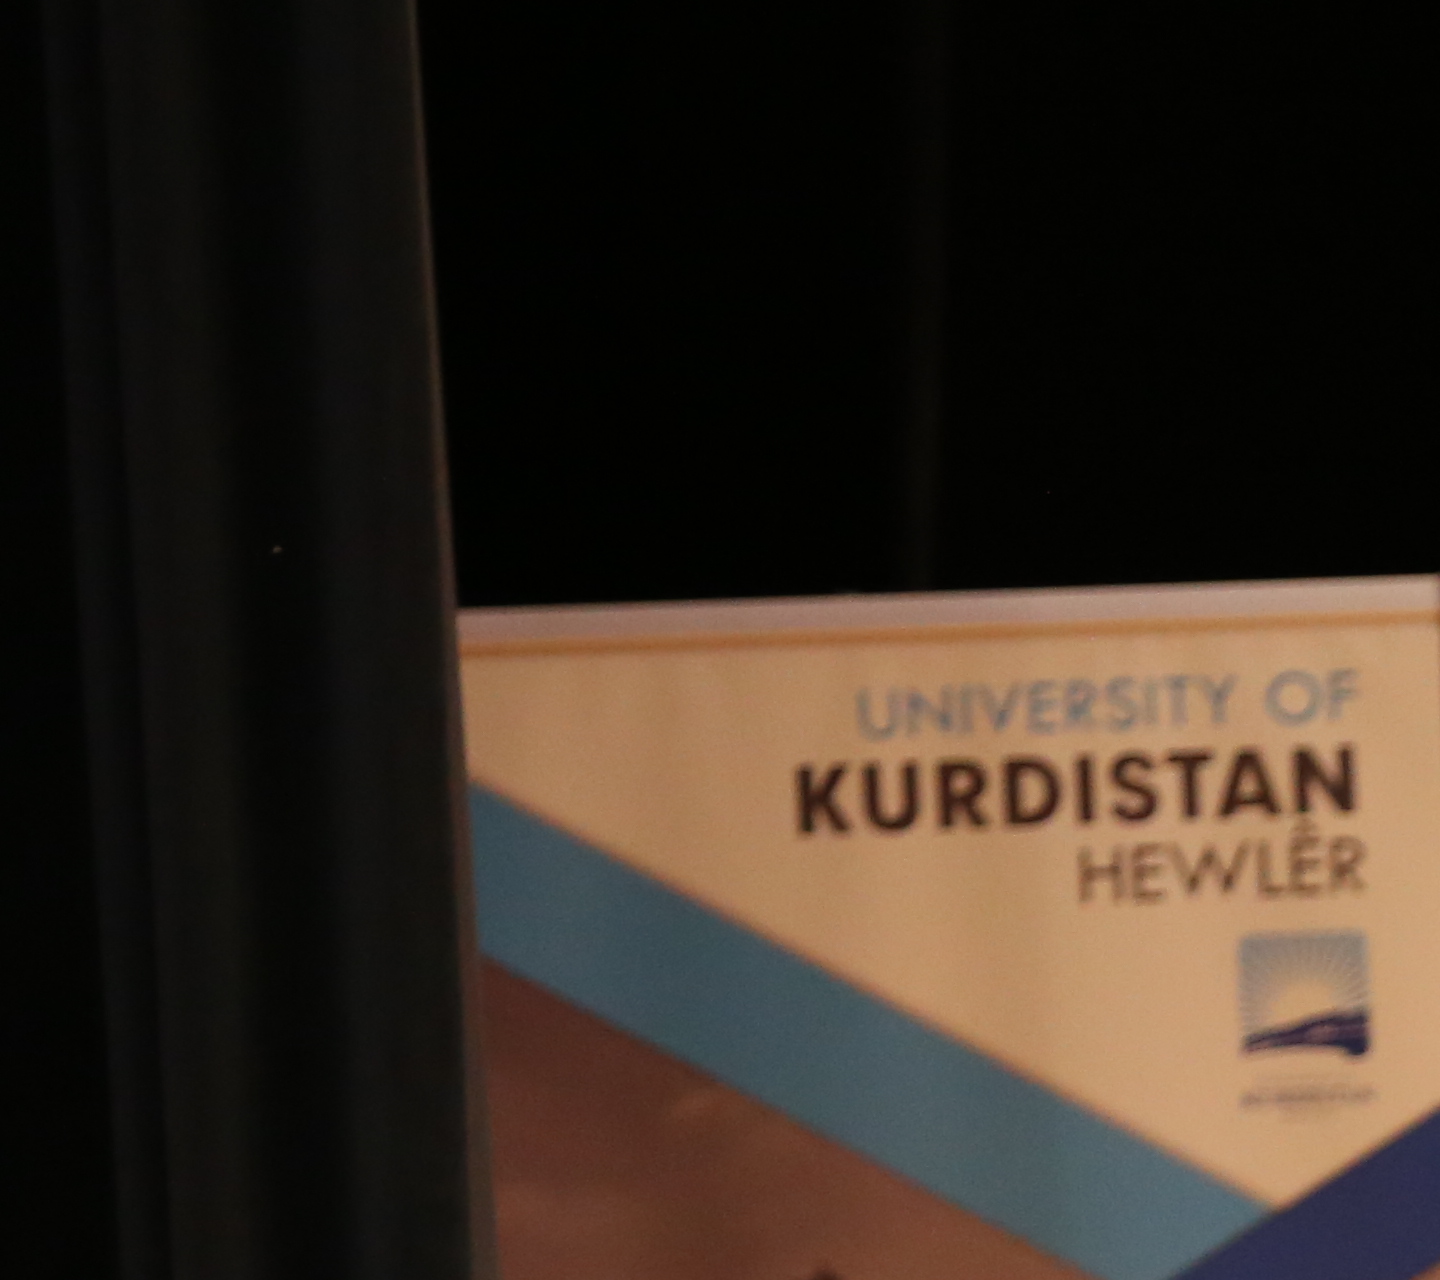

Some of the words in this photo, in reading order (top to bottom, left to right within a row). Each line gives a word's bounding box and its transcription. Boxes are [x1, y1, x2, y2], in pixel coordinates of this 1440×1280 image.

[858, 677, 1234, 739] UNIVERSITY
[1265, 670, 1361, 726] OF
[797, 744, 1356, 834] KURDISTAN
[1077, 818, 1367, 904] HEWLÊR
